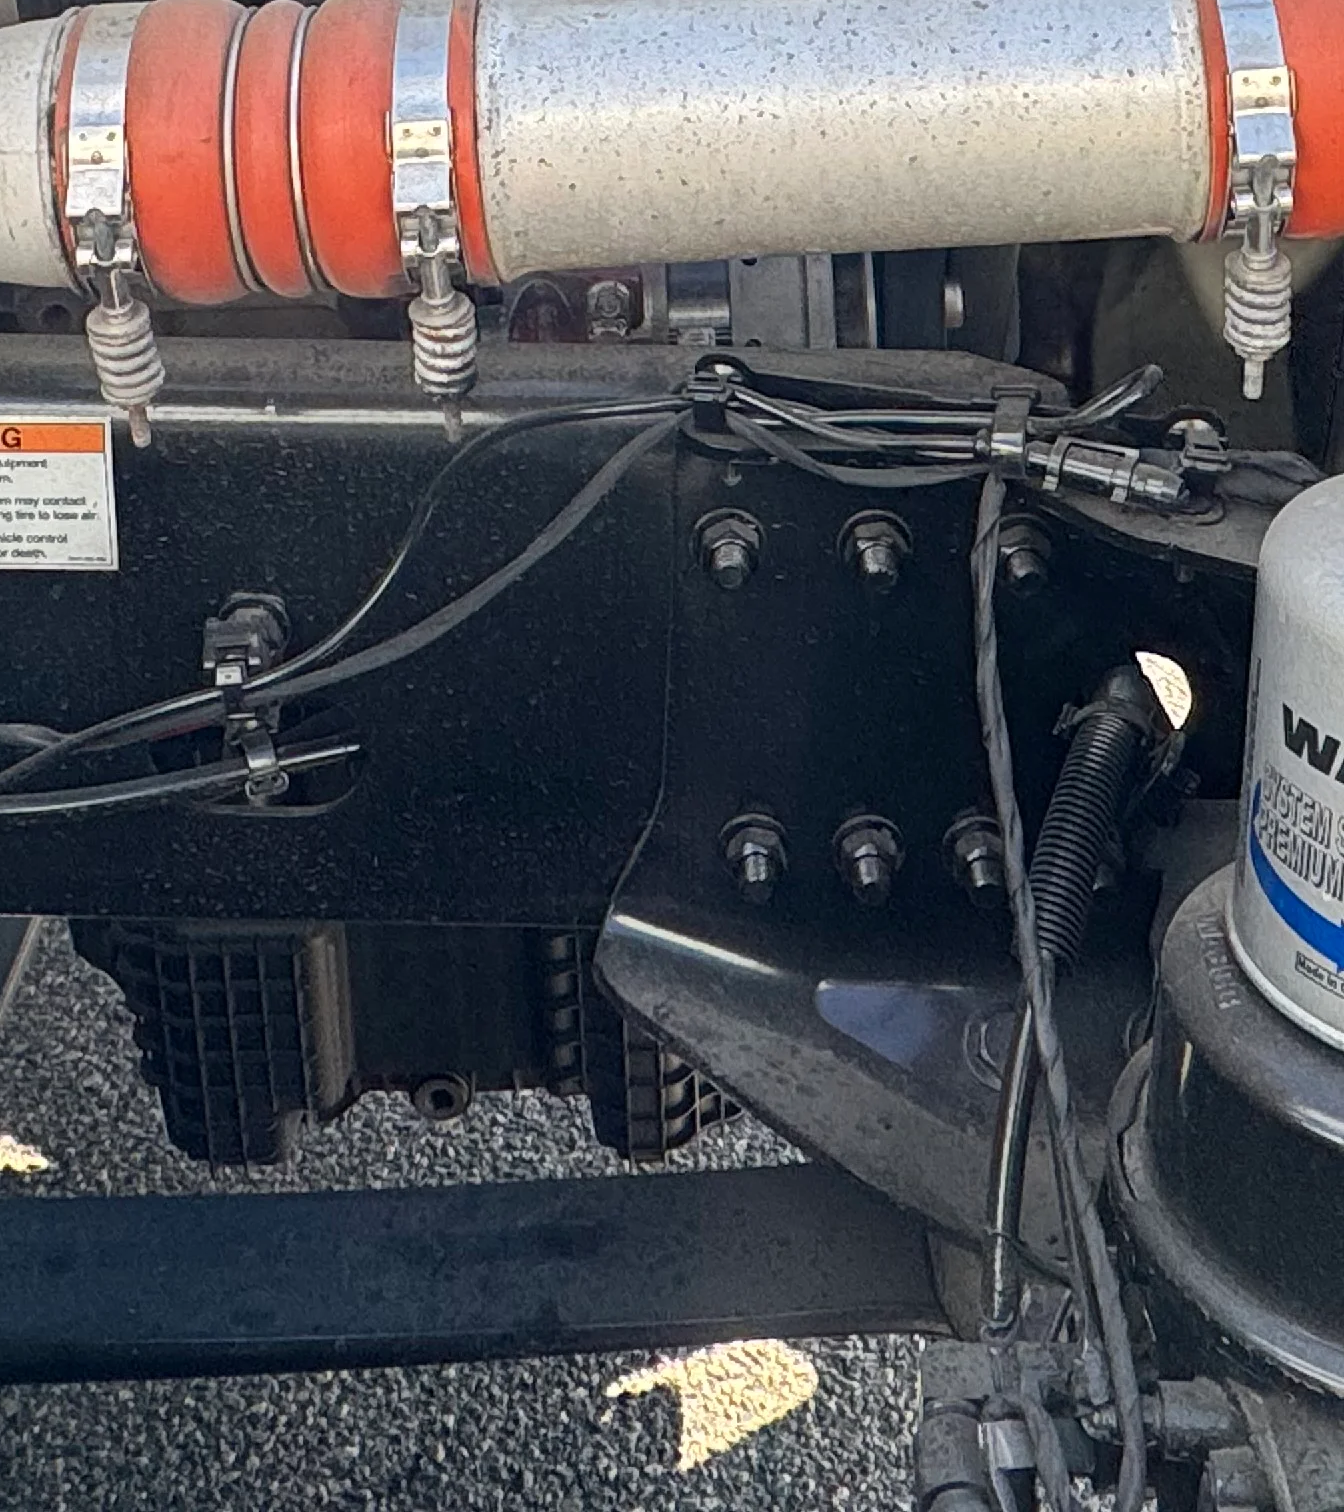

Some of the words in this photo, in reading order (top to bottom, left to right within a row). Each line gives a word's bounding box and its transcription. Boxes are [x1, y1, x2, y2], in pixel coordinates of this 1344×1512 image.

[15, 497, 39, 507] may
[43, 496, 86, 506] contact
[15, 510, 35, 520] tire
[38, 510, 49, 520] to
[27, 533, 67, 543] control
[1263, 763, 1333, 850] SYSTEM
[1297, 953, 1325, 981] Made
[1326, 972, 1338, 990] in
